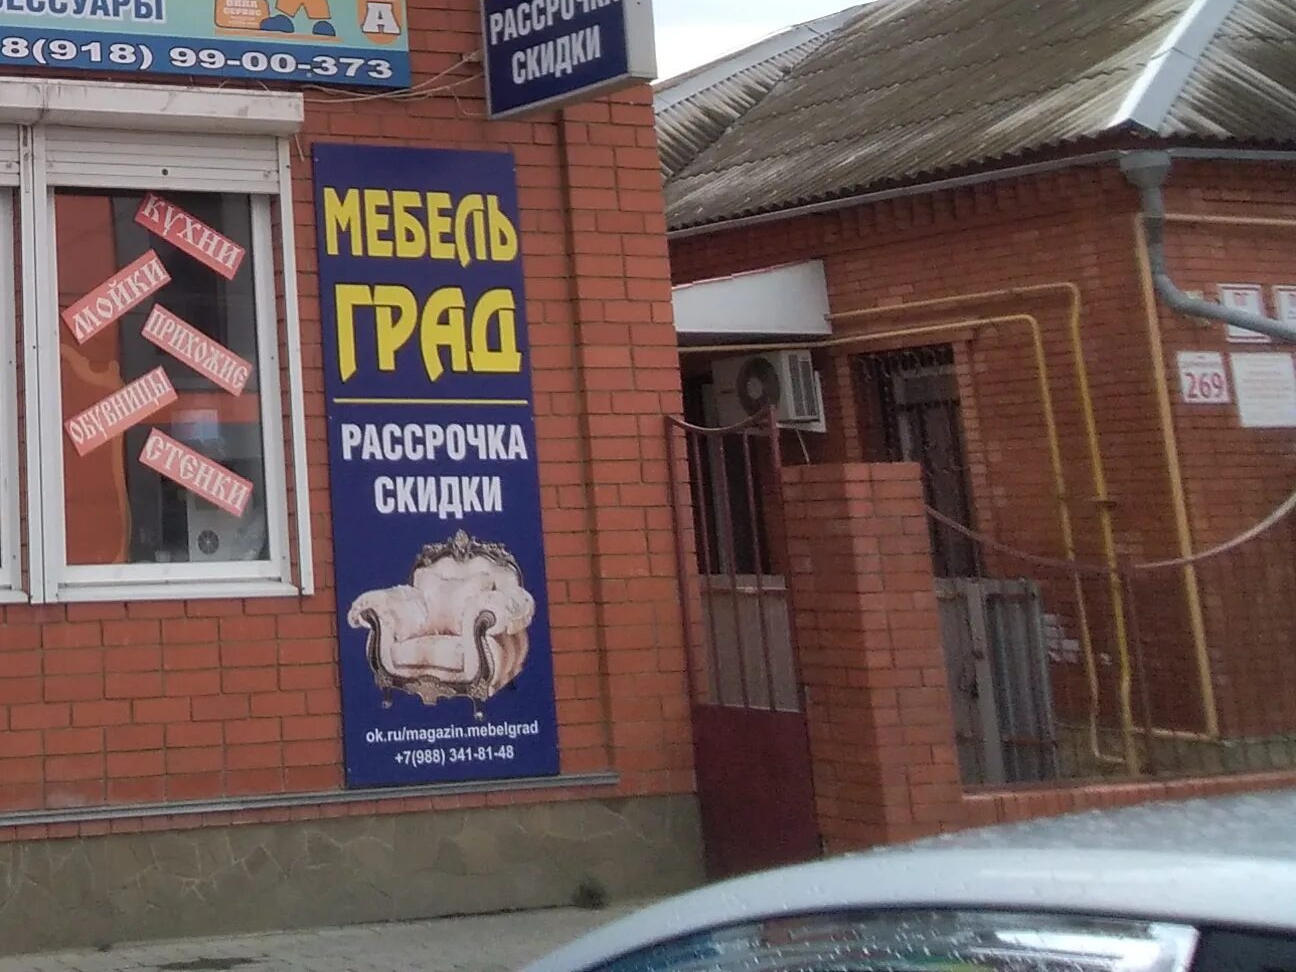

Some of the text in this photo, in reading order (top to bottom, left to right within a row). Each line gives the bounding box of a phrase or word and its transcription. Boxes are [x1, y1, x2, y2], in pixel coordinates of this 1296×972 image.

[1, 37, 393, 79] 8(918) 99-00-373
[512, 24, 601, 85] СКИДКИ
[141, 194, 242, 269] КУХНИ
[323, 187, 518, 268] МЕБЕЛЬ
[73, 259, 168, 339] МОЙКИ
[146, 309, 249, 389] ПРИХОЖИЕ
[335, 284, 522, 382] ГРАД
[69, 369, 172, 444] ОБУВНИЦЫ
[1185, 372, 1224, 399] 269
[145, 435, 249, 509] СТЕНКИ
[341, 423, 528, 460] РАССРОЧКА
[374, 476, 502, 520] СКИДКИ
[366, 720, 538, 745] ok.ru/magazin.mebelgrad
[395, 745, 514, 767] +7(988) 341-81-48
